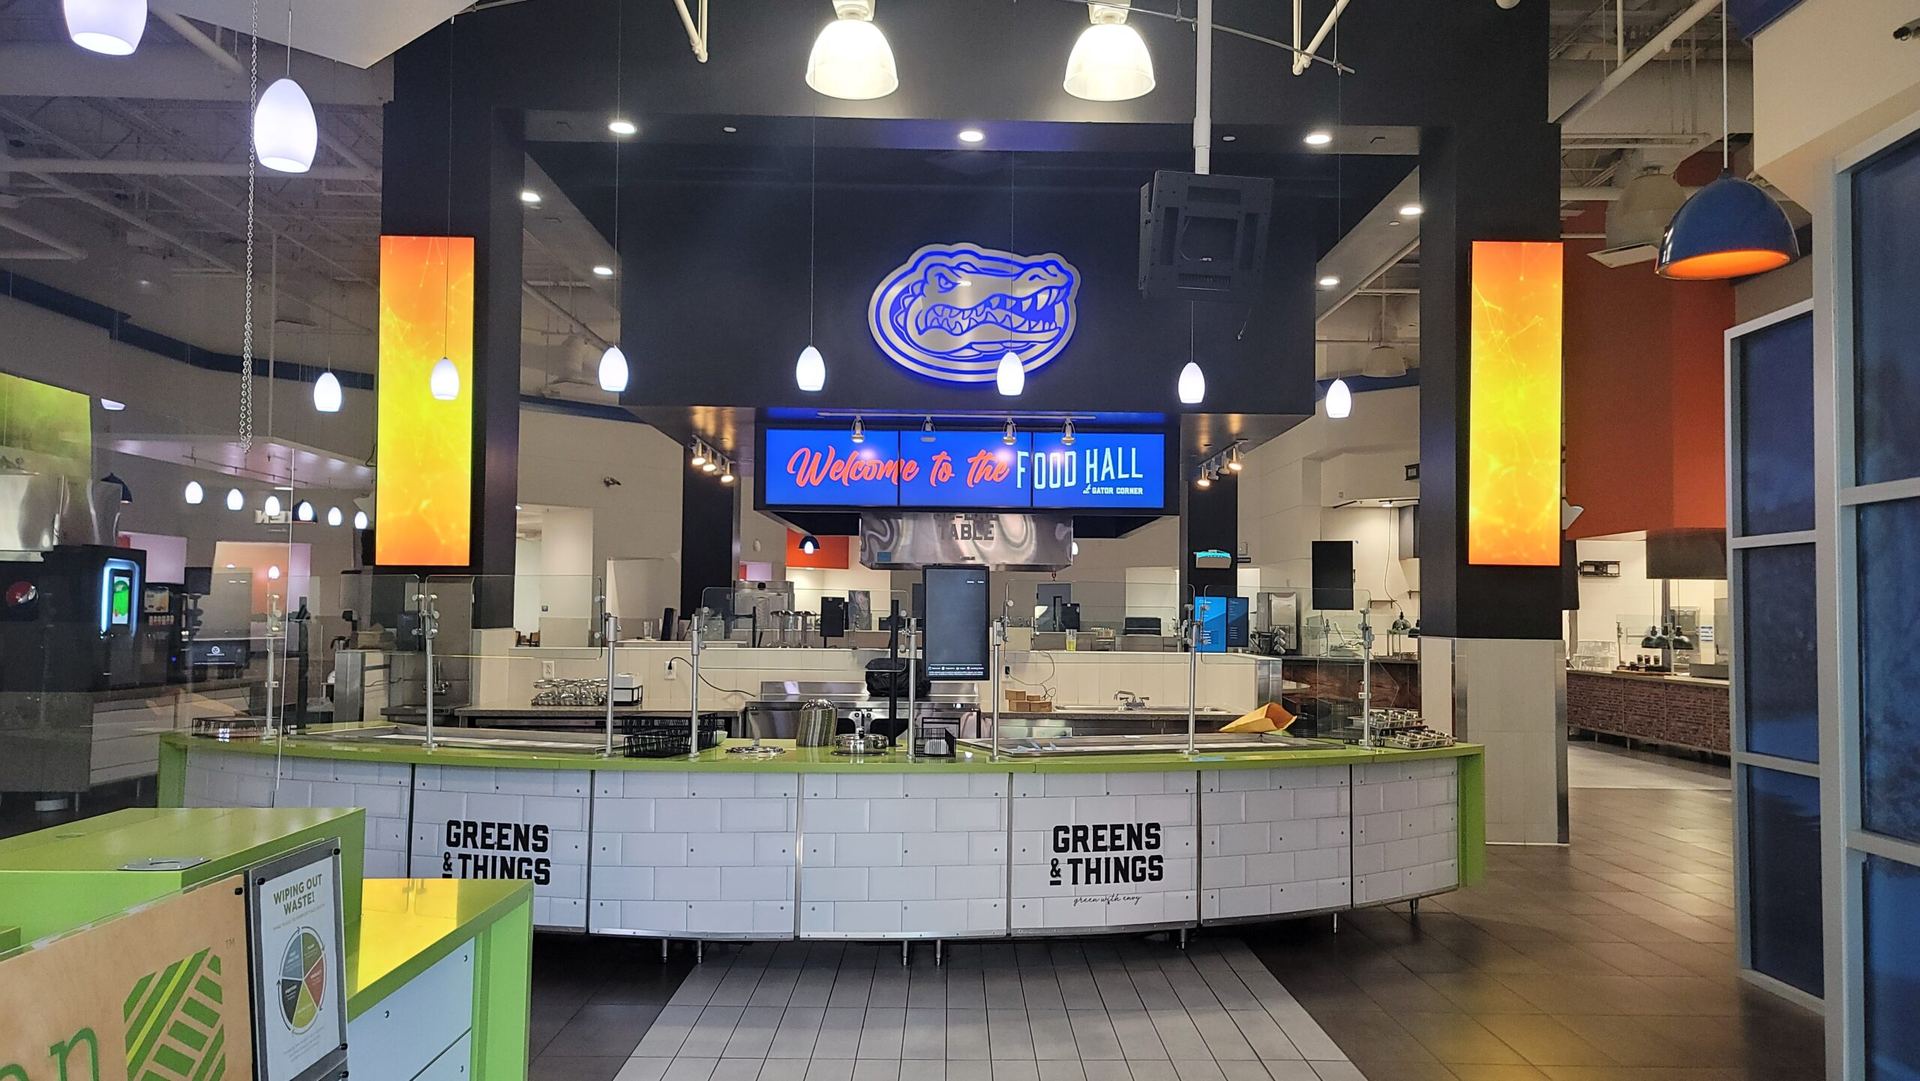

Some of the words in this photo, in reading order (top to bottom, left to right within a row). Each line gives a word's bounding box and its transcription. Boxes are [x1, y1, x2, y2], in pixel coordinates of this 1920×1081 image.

[787, 445, 920, 487] Welcome
[930, 451, 955, 487] to
[966, 449, 1010, 488] the
[1016, 450, 1077, 489] FOOD
[1085, 446, 1144, 483] HALL
[1091, 486, 1114, 495] GATOR
[1115, 486, 1144, 495] CORNER
[446, 820, 549, 852] GREENS
[1053, 823, 1161, 853] GREENS
[442, 852, 452, 877] &
[458, 854, 551, 885] THINGS
[1050, 858, 1061, 885] &
[1067, 855, 1164, 885] THINGS
[273, 881, 305, 905] WIPING
[306, 874, 322, 890] OUT
[283, 891, 315, 916] WASTE!
[1073, 896, 1099, 907] green
[1122, 895, 1142, 905] envy
